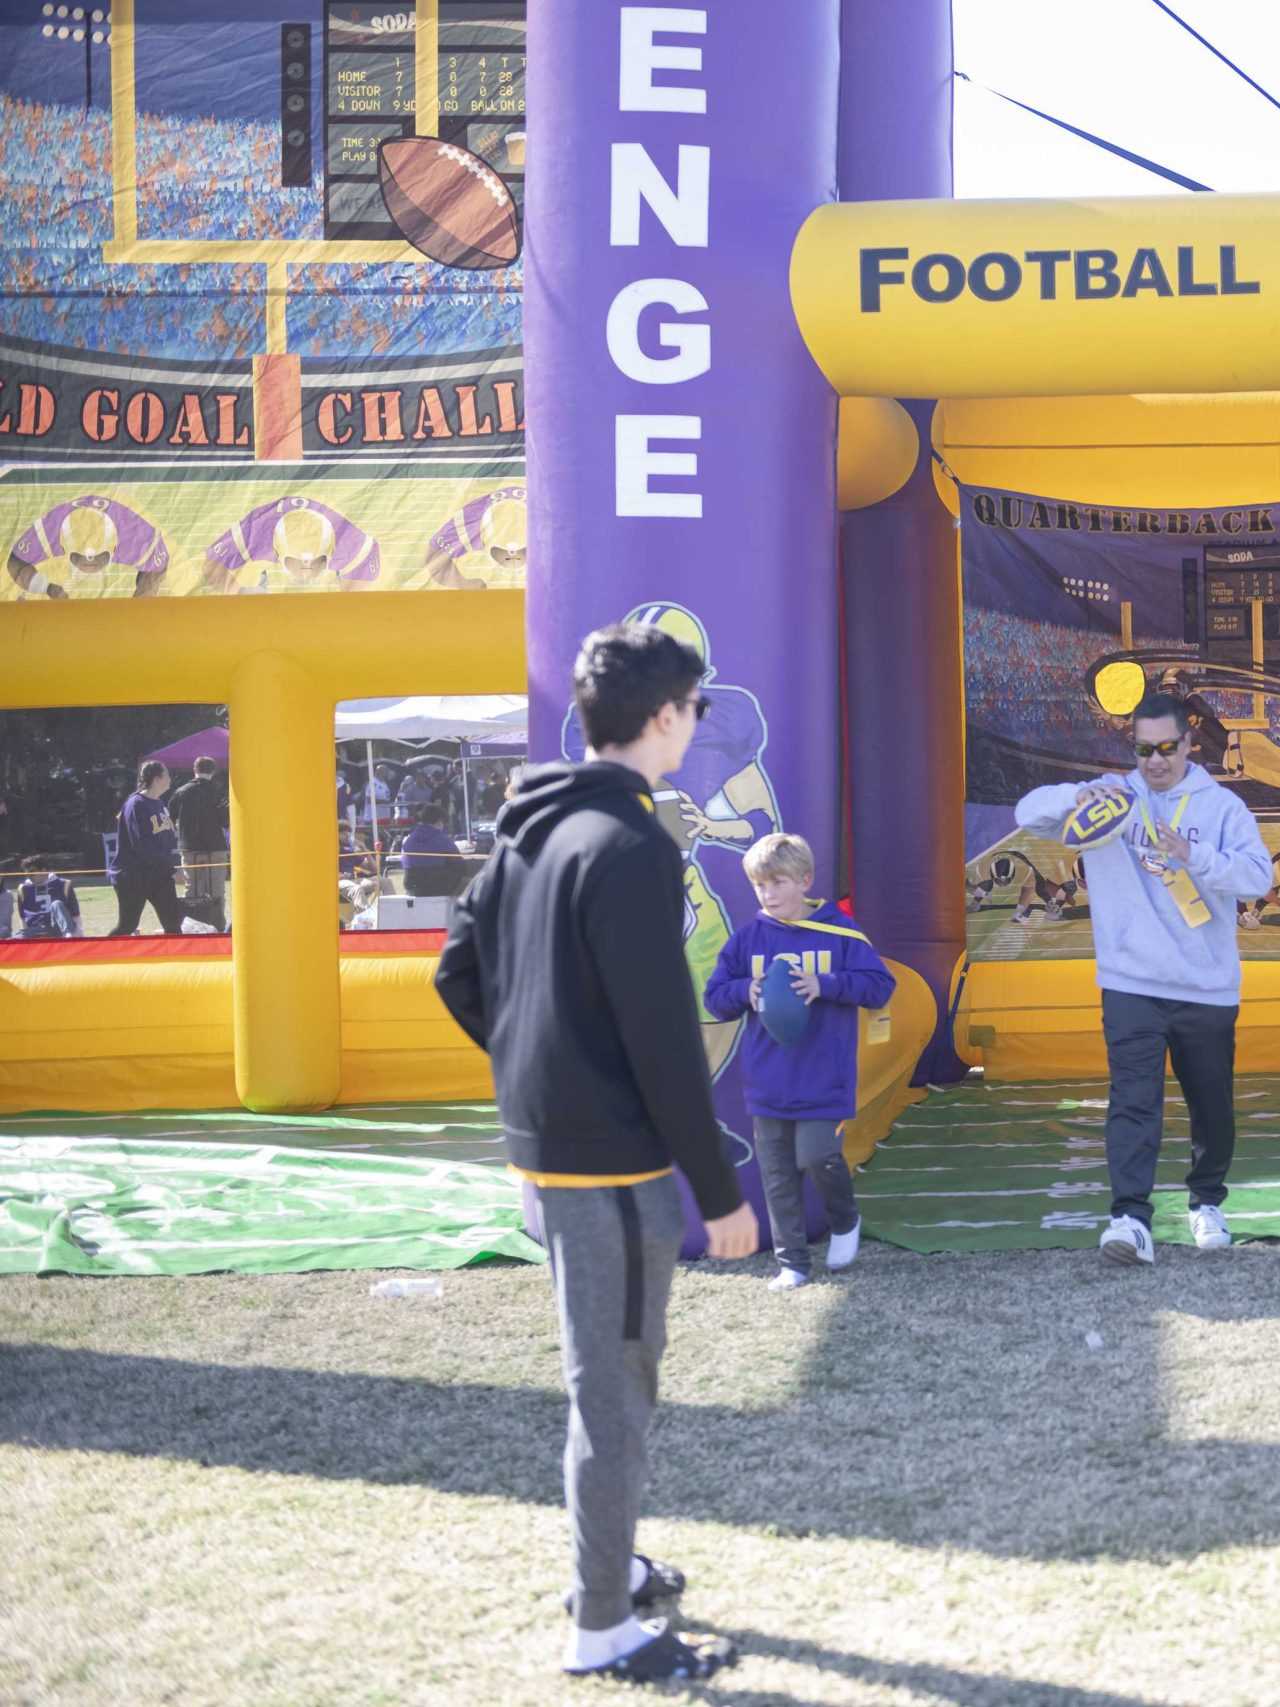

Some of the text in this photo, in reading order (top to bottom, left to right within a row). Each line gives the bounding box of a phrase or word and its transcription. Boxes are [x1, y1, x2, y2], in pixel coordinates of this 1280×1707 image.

[338, 71, 367, 82] HOME
[338, 86, 381, 97] VISITOR
[337, 100, 345, 111] 4
[351, 100, 381, 111] DOWN
[471, 100, 498, 111] BALL
[500, 100, 515, 111] ON
[341, 137, 365, 148] TIME
[342, 151, 367, 162] PLAY
[858, 244, 1261, 313] FOOTBALL
[81, 388, 250, 446] GOAL
[972, 493, 1276, 536] QUARTERBACK
[1227, 551, 1254, 564] SODA
[1071, 794, 1130, 840] LSU
